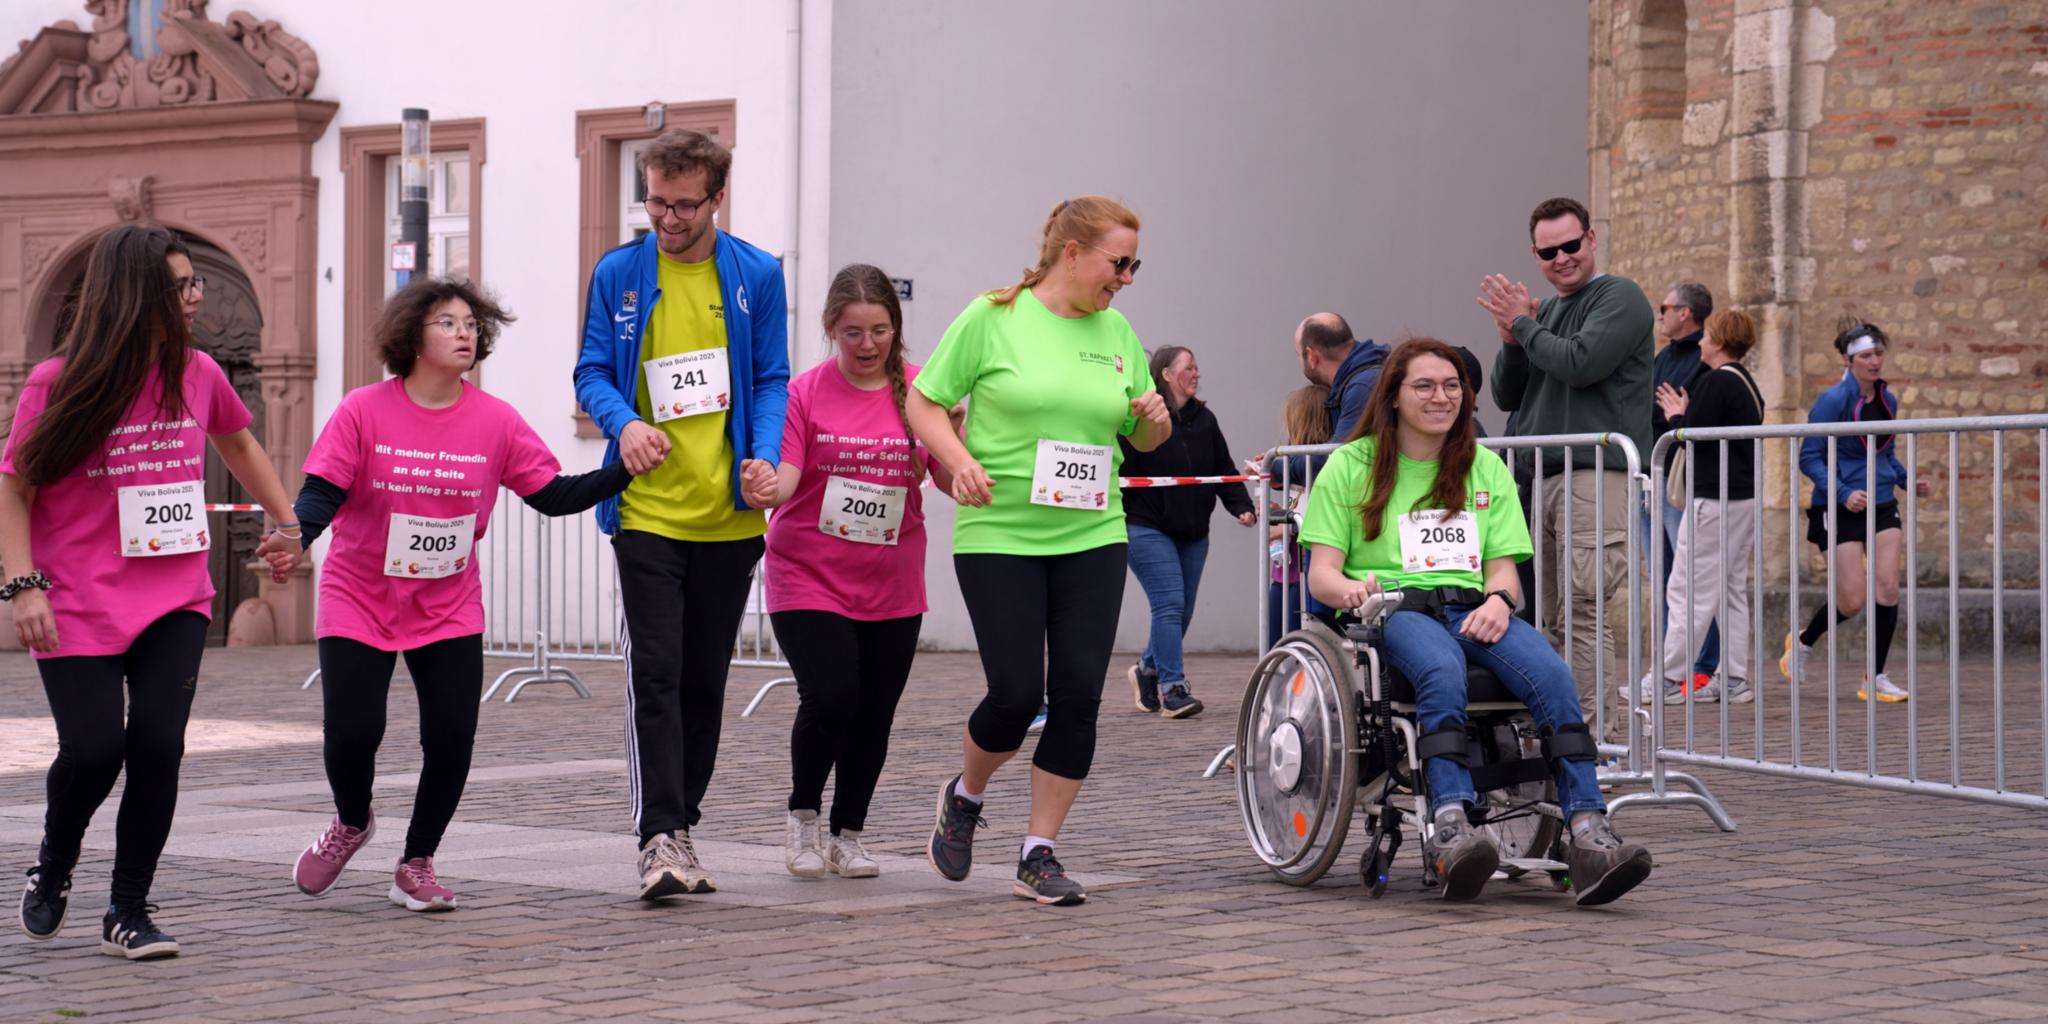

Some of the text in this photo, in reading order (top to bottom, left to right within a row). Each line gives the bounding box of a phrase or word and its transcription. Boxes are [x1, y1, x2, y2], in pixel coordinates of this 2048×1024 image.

[325, 267, 333, 283] 4
[658, 353, 716, 369] Viva Bolivia 2025
[671, 369, 708, 390] 241
[109, 438, 184, 457] an der Seite
[817, 434, 921, 446] Mit meiner Freu
[375, 443, 487, 463] Mit meiner Freundin
[839, 450, 910, 462] an der Seite
[1054, 445, 1105, 457] Viva Bolivia 2025
[107, 463, 135, 476] kein
[138, 461, 163, 472] Weg
[166, 459, 181, 468] zu
[393, 465, 465, 480] an der Seite
[832, 464, 856, 473] kein
[859, 465, 884, 477] Weg
[887, 468, 901, 477] zu
[1055, 461, 1097, 481] 2051
[138, 485, 194, 497] Viva Bolivia 2025
[373, 479, 385, 490] ist
[388, 482, 412, 494] kein
[416, 484, 441, 497] Weg
[443, 488, 458, 496] zu
[843, 481, 897, 497] Viva Bolivia 2025
[144, 502, 194, 525] 2002
[841, 497, 887, 518] 2001
[408, 519, 465, 529] Viva Bolivia 2025
[409, 534, 457, 552] 2003
[1420, 527, 1467, 544] 2068
